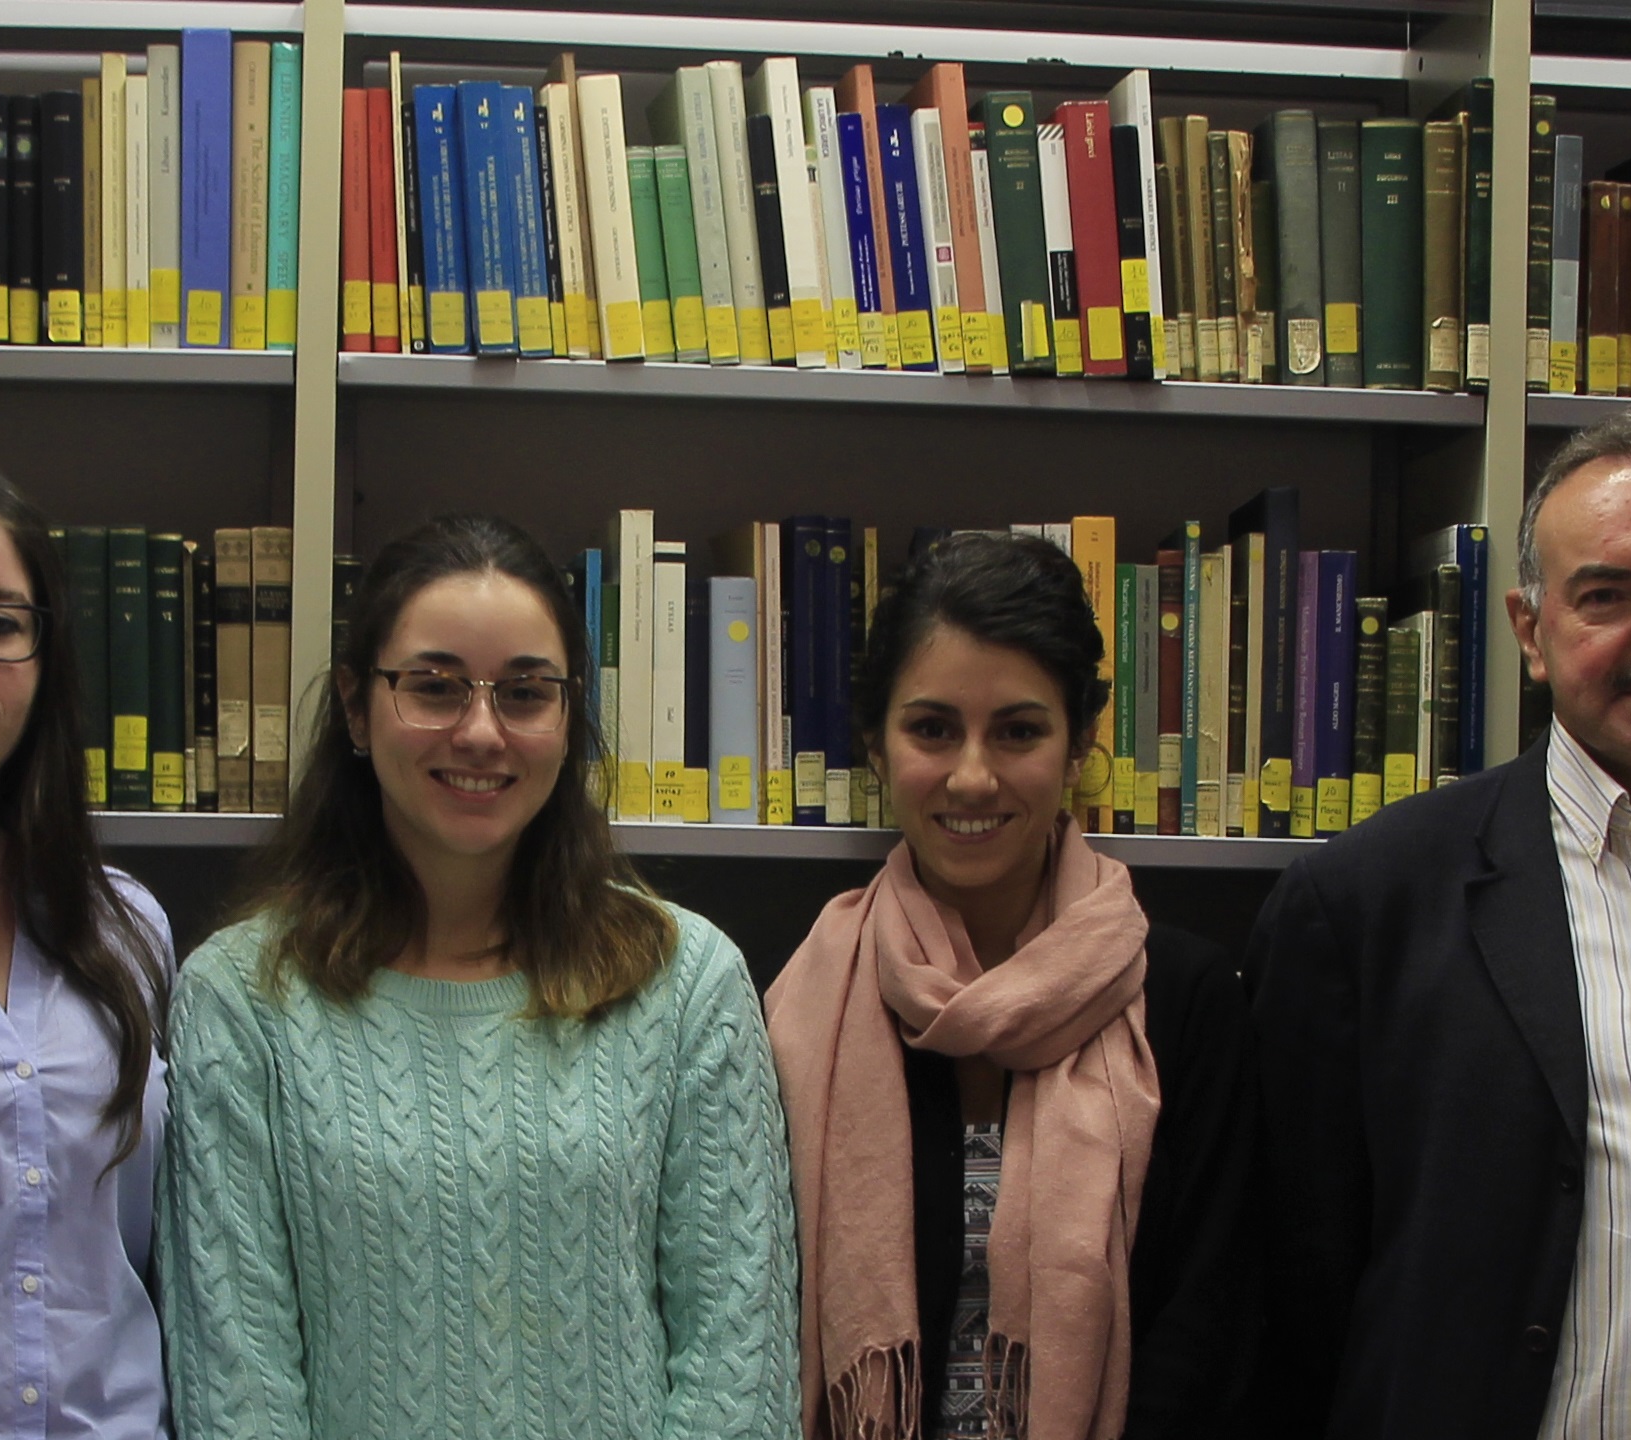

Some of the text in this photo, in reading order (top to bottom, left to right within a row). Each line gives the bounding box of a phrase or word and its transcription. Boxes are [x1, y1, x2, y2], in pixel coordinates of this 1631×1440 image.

[251, 137, 263, 161] The
[1084, 112, 1097, 159] Lirici greci
[251, 164, 262, 206] School
[277, 152, 291, 239] IMAGINARY
[1386, 194, 1399, 205] III
[249, 223, 261, 276] Libanius
[156, 589, 178, 599] OBRAS
[1121, 577, 1131, 617] Macarius,
[1335, 573, 1344, 625] MANICHEISMO
[162, 612, 173, 622] VI
[667, 601, 675, 634] LYSIAS
[1298, 606, 1310, 653] Manichaean
[1121, 619, 1131, 664] Apocriticus
[1332, 681, 1341, 710] MAGRIS
[1325, 786, 1337, 797] 10
